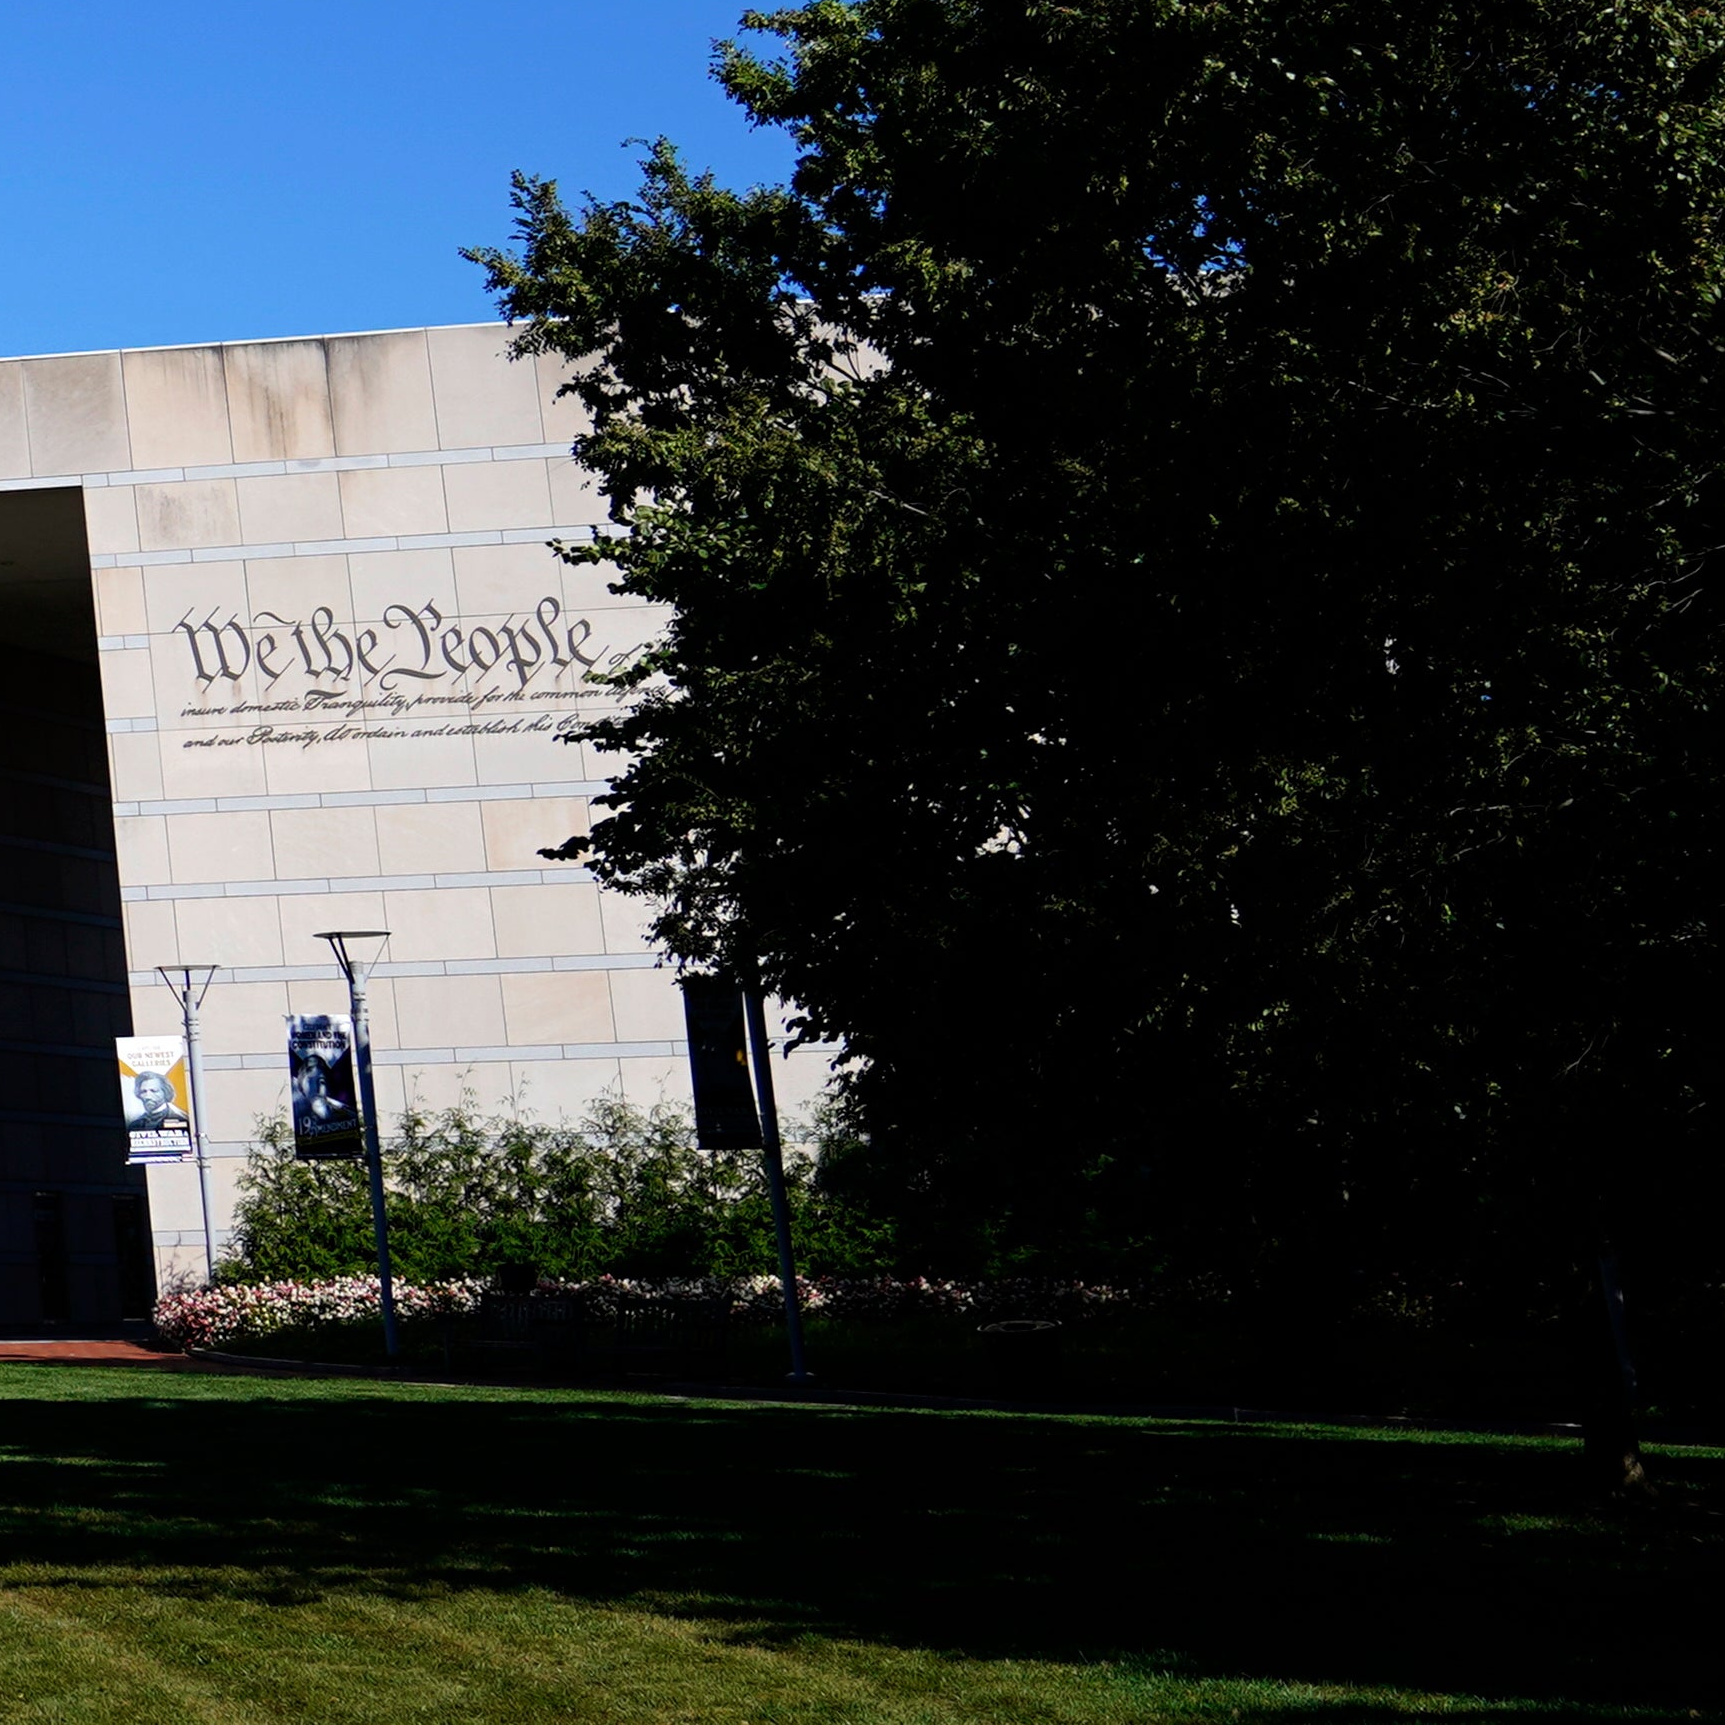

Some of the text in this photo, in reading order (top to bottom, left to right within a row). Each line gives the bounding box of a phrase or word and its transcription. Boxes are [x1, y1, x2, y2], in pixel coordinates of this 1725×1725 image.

[172, 605, 295, 693] We
[292, 606, 397, 686] the
[380, 595, 610, 690] People
[180, 702, 227, 717] insure
[230, 697, 301, 715] domestic
[407, 689, 482, 710] provide
[471, 685, 509, 711] for
[508, 685, 529, 702] the
[530, 688, 603, 701] common
[182, 736, 217, 749] and
[217, 736, 247, 747] our
[409, 724, 450, 738] and
